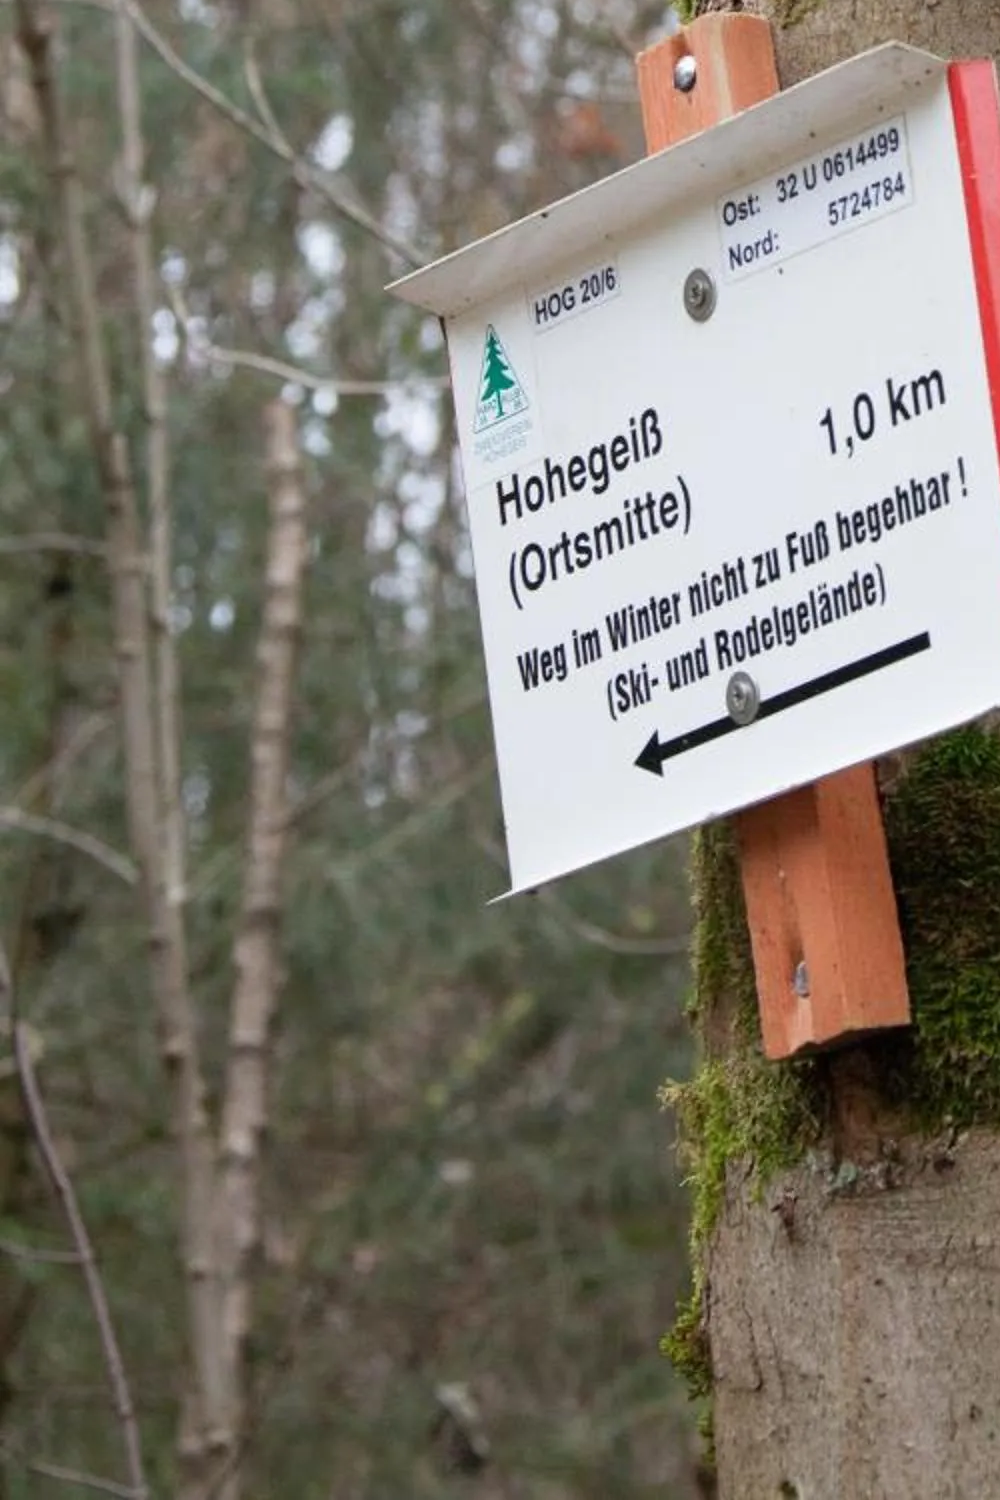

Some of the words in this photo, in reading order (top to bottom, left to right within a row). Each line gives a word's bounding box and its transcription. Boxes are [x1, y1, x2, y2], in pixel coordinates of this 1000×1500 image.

[723, 194, 761, 227] Ost:
[775, 173, 799, 203] 32
[803, 164, 818, 191] U
[822, 128, 900, 182] 0614499
[728, 229, 780, 271] Nord:
[828, 172, 906, 226] 5724784
[535, 285, 575, 324] HOG
[579, 266, 616, 304] 20/6
[496, 407, 663, 526] Hohegeiß
[510, 475, 692, 610] (Ortsmitte)
[818, 392, 876, 459] 1,0
[886, 368, 947, 428] km
[516, 643, 568, 693] Weg
[571, 627, 603, 670] im
[605, 591, 682, 652] Winter
[688, 556, 749, 618] nicht
[752, 546, 782, 590] zu
[786, 519, 831, 574] Fuß
[606, 661, 660, 722] (Ski-
[666, 637, 709, 693] und
[714, 562, 888, 672] Rodelgelände)
